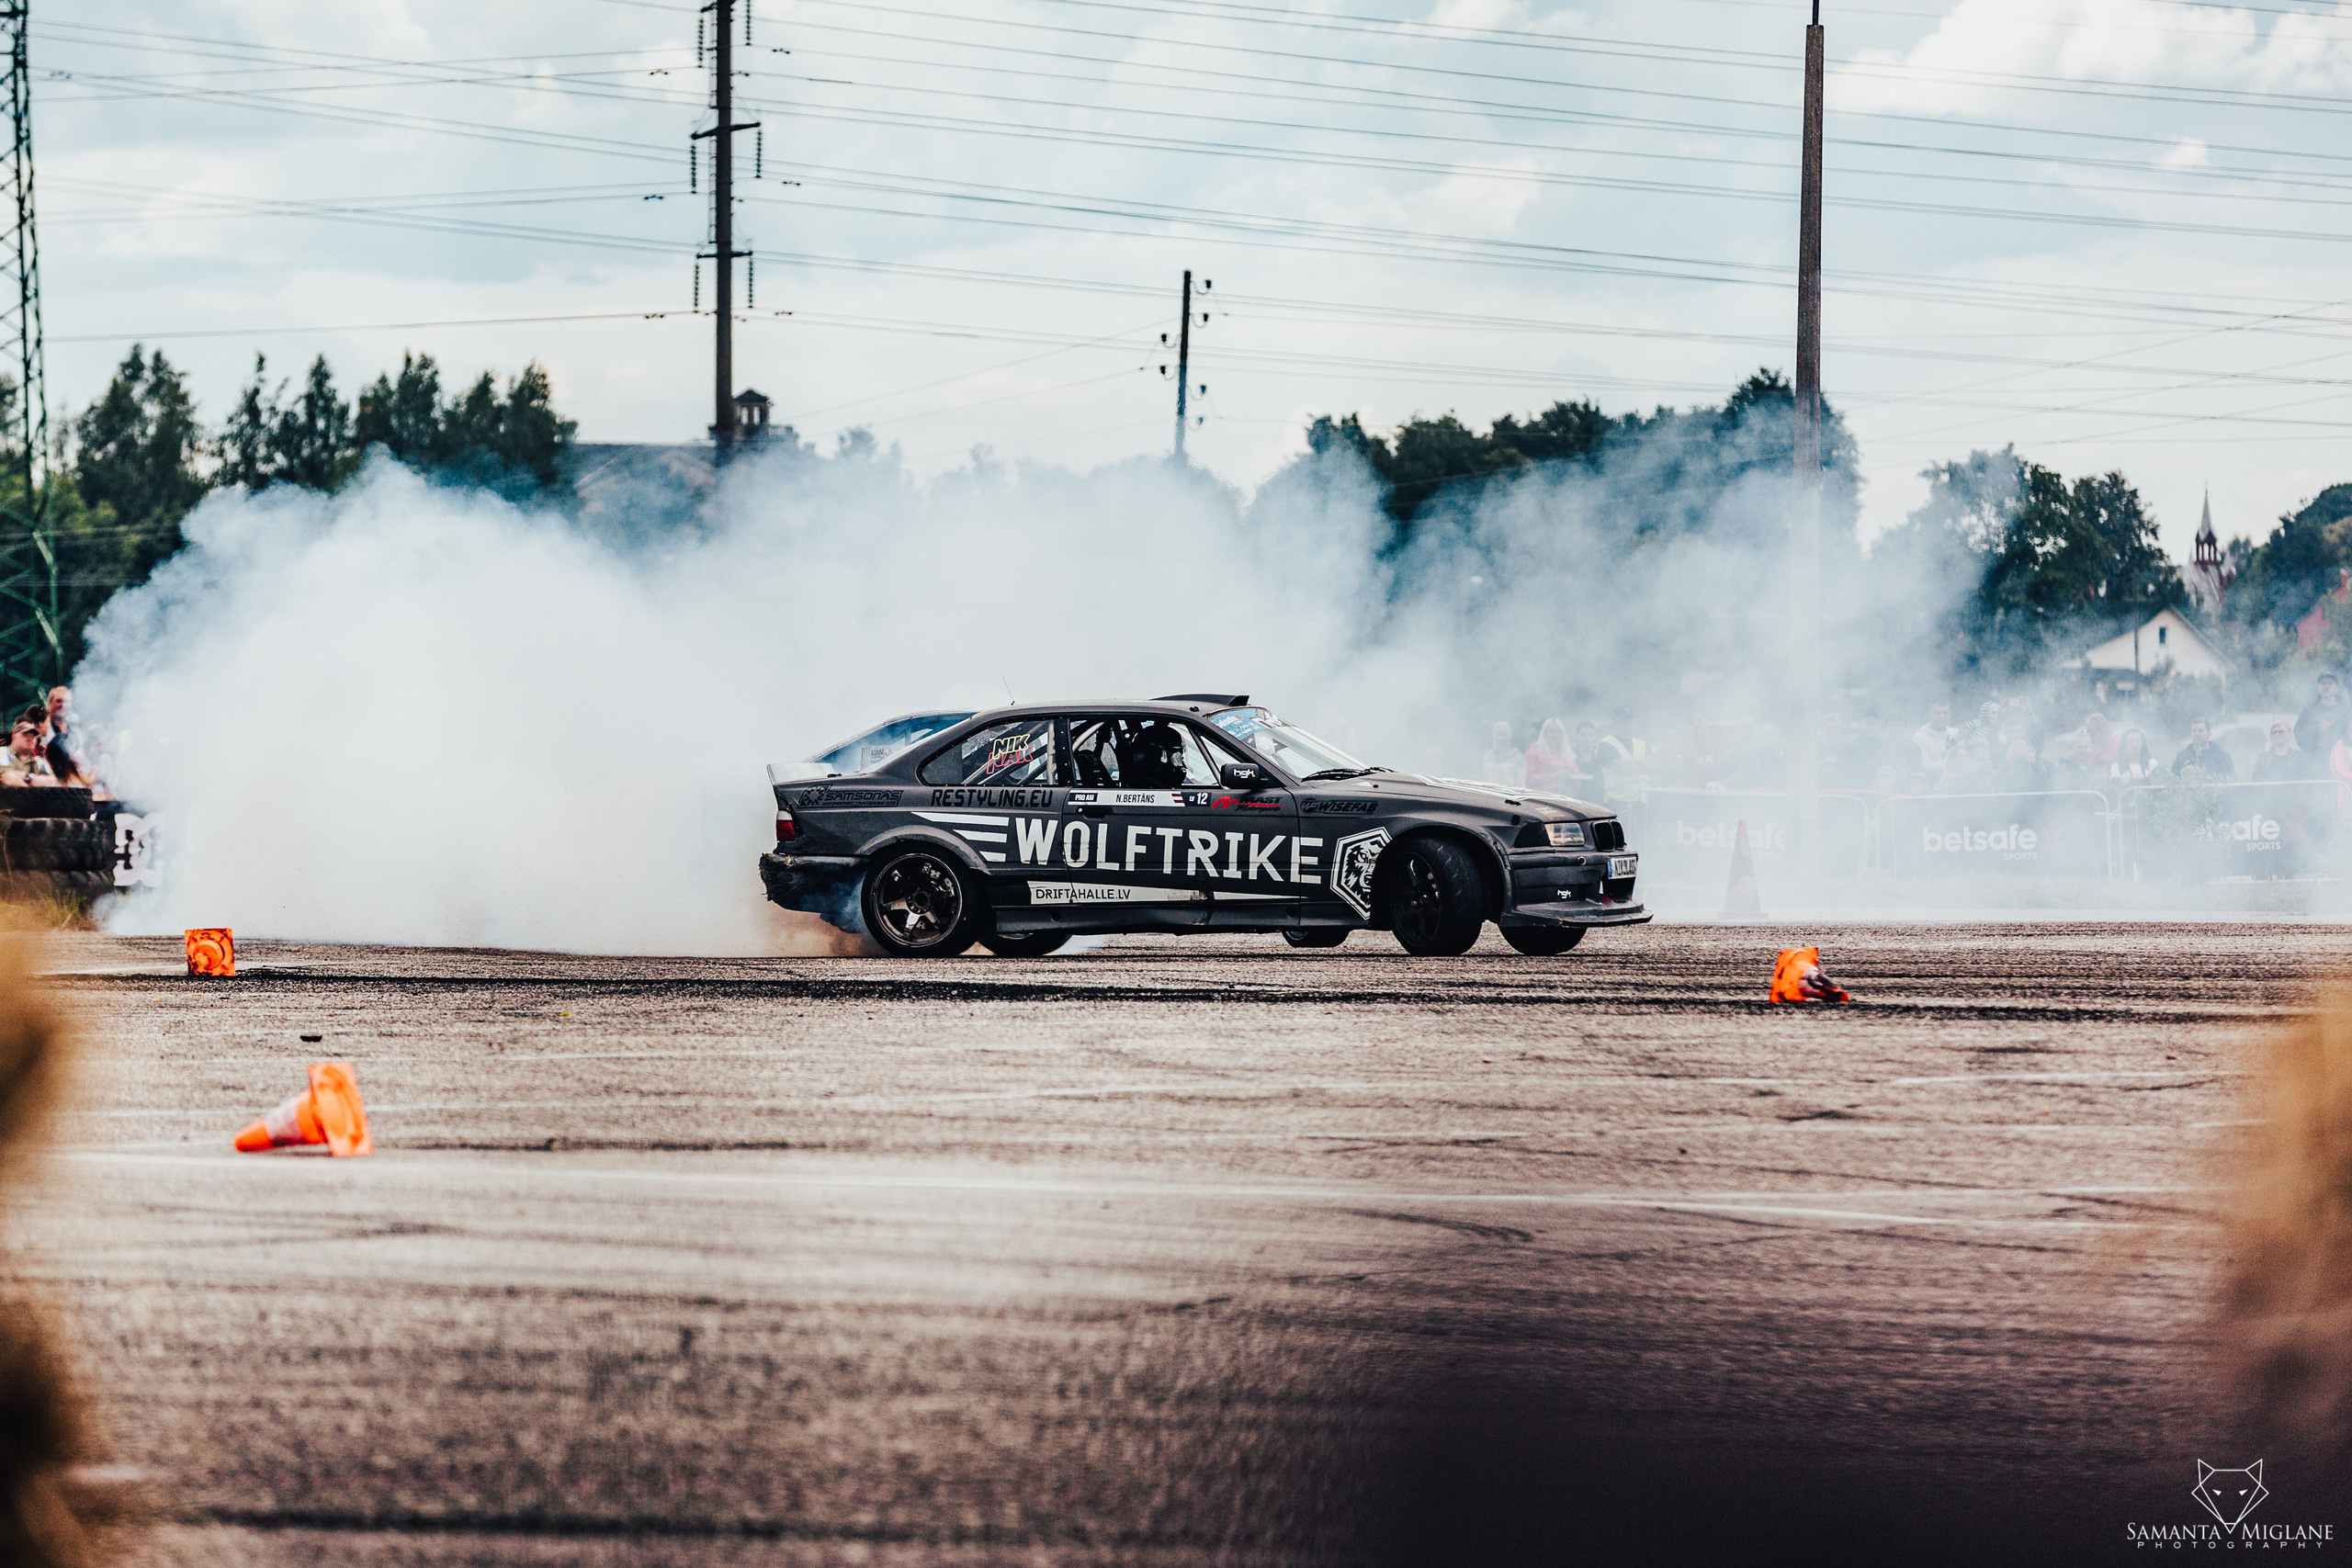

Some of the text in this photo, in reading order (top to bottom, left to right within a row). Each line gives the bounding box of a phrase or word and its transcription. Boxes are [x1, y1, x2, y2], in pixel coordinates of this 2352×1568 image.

[992, 734, 1031, 761] NIK
[823, 790, 901, 801] SAMSONAS
[931, 789, 1053, 807] RESTYLING.EU
[1196, 792, 1208, 805] 12
[1317, 801, 1378, 812] WISEFAB
[1922, 823, 2039, 852] betsafe
[1015, 818, 1323, 885] WOLFTRIKE
[2245, 841, 2281, 852] SPORTS
[2003, 852, 2039, 862] SPORTS
[1035, 888, 1131, 900] DRIFTAHALLE.LV
